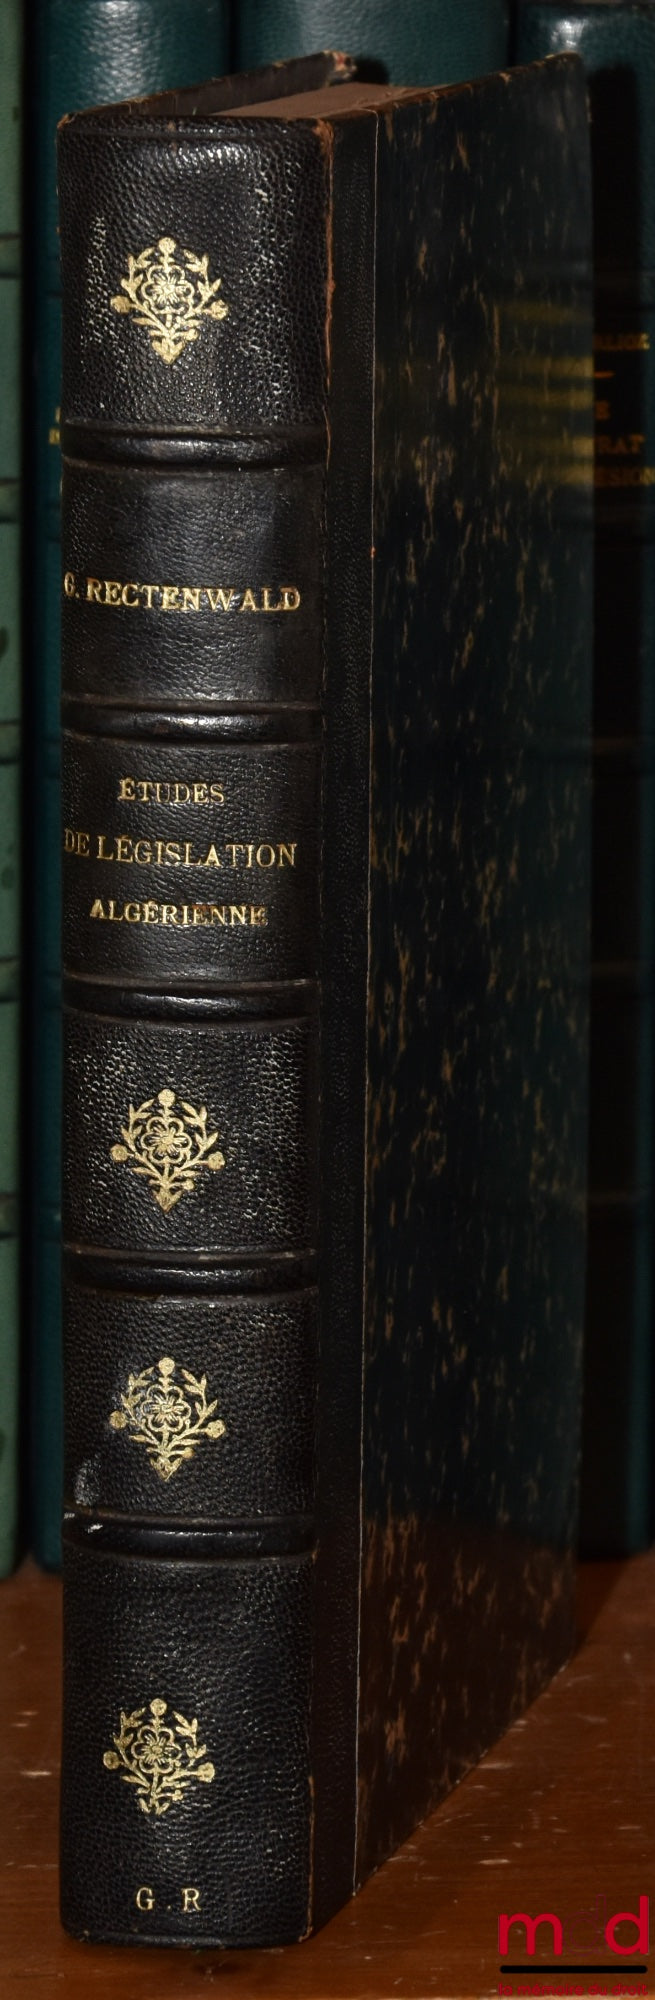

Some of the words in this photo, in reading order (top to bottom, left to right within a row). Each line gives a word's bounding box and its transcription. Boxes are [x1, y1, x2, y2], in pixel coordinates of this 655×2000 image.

[63, 573, 80, 598] G.
[87, 577, 301, 612] RECTENWALD
[118, 777, 226, 804] ÉTUDES
[64, 827, 90, 859] DE
[97, 834, 298, 869] LÉGISLATION
[90, 898, 269, 927] ALGÉRIENNE
